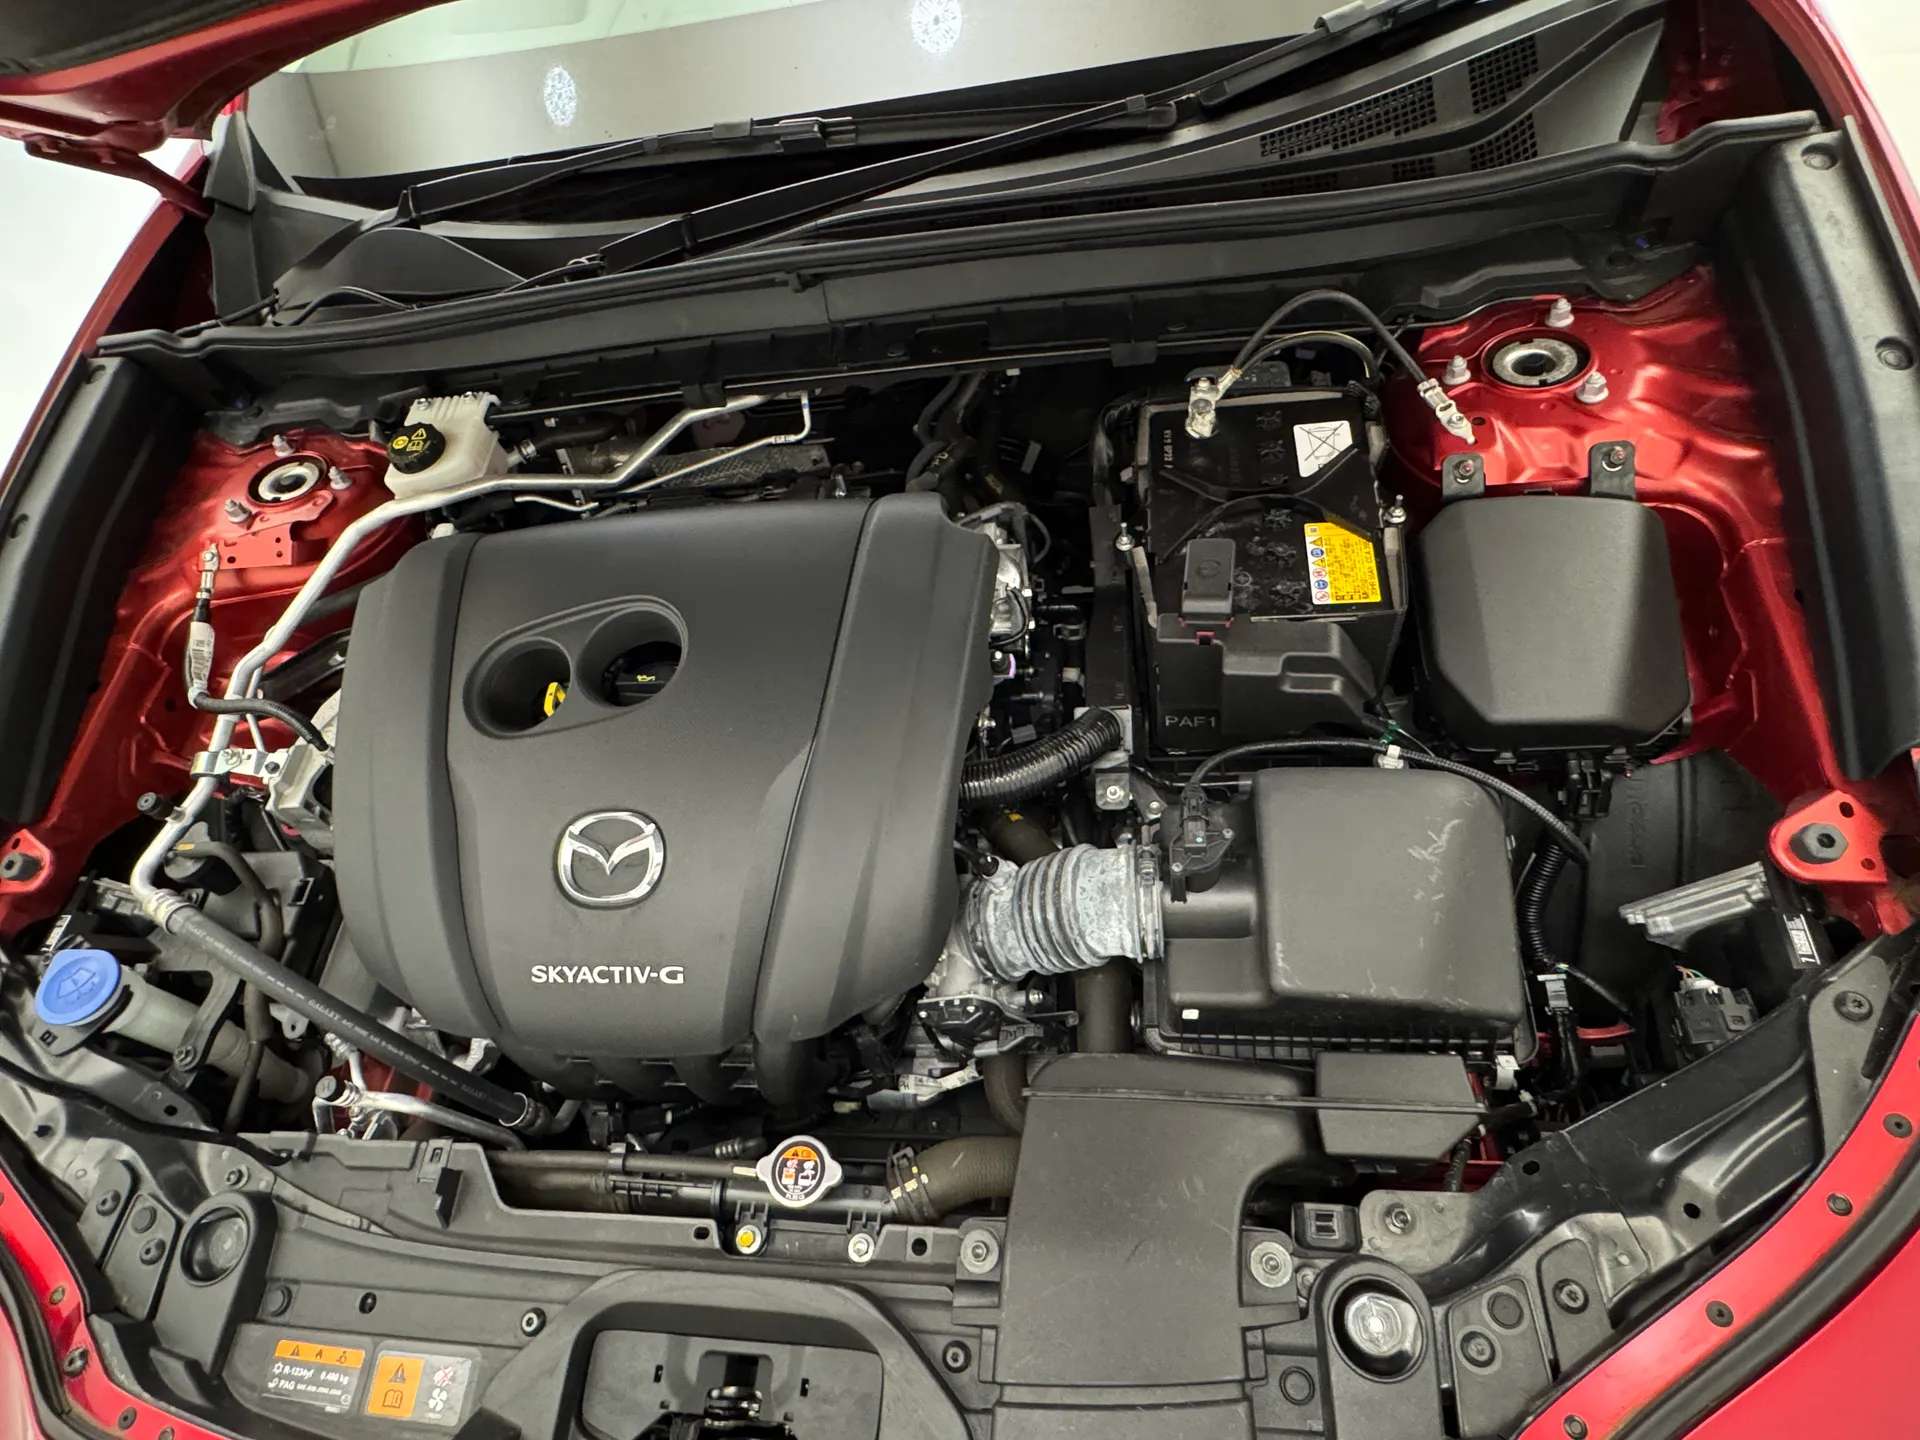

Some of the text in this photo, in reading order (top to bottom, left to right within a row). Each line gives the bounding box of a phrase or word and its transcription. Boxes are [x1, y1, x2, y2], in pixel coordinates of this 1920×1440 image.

[1165, 715, 1216, 728] PAF1
[530, 964, 685, 985] SKYACTIV-G
[278, 1378, 296, 1391] PAG
